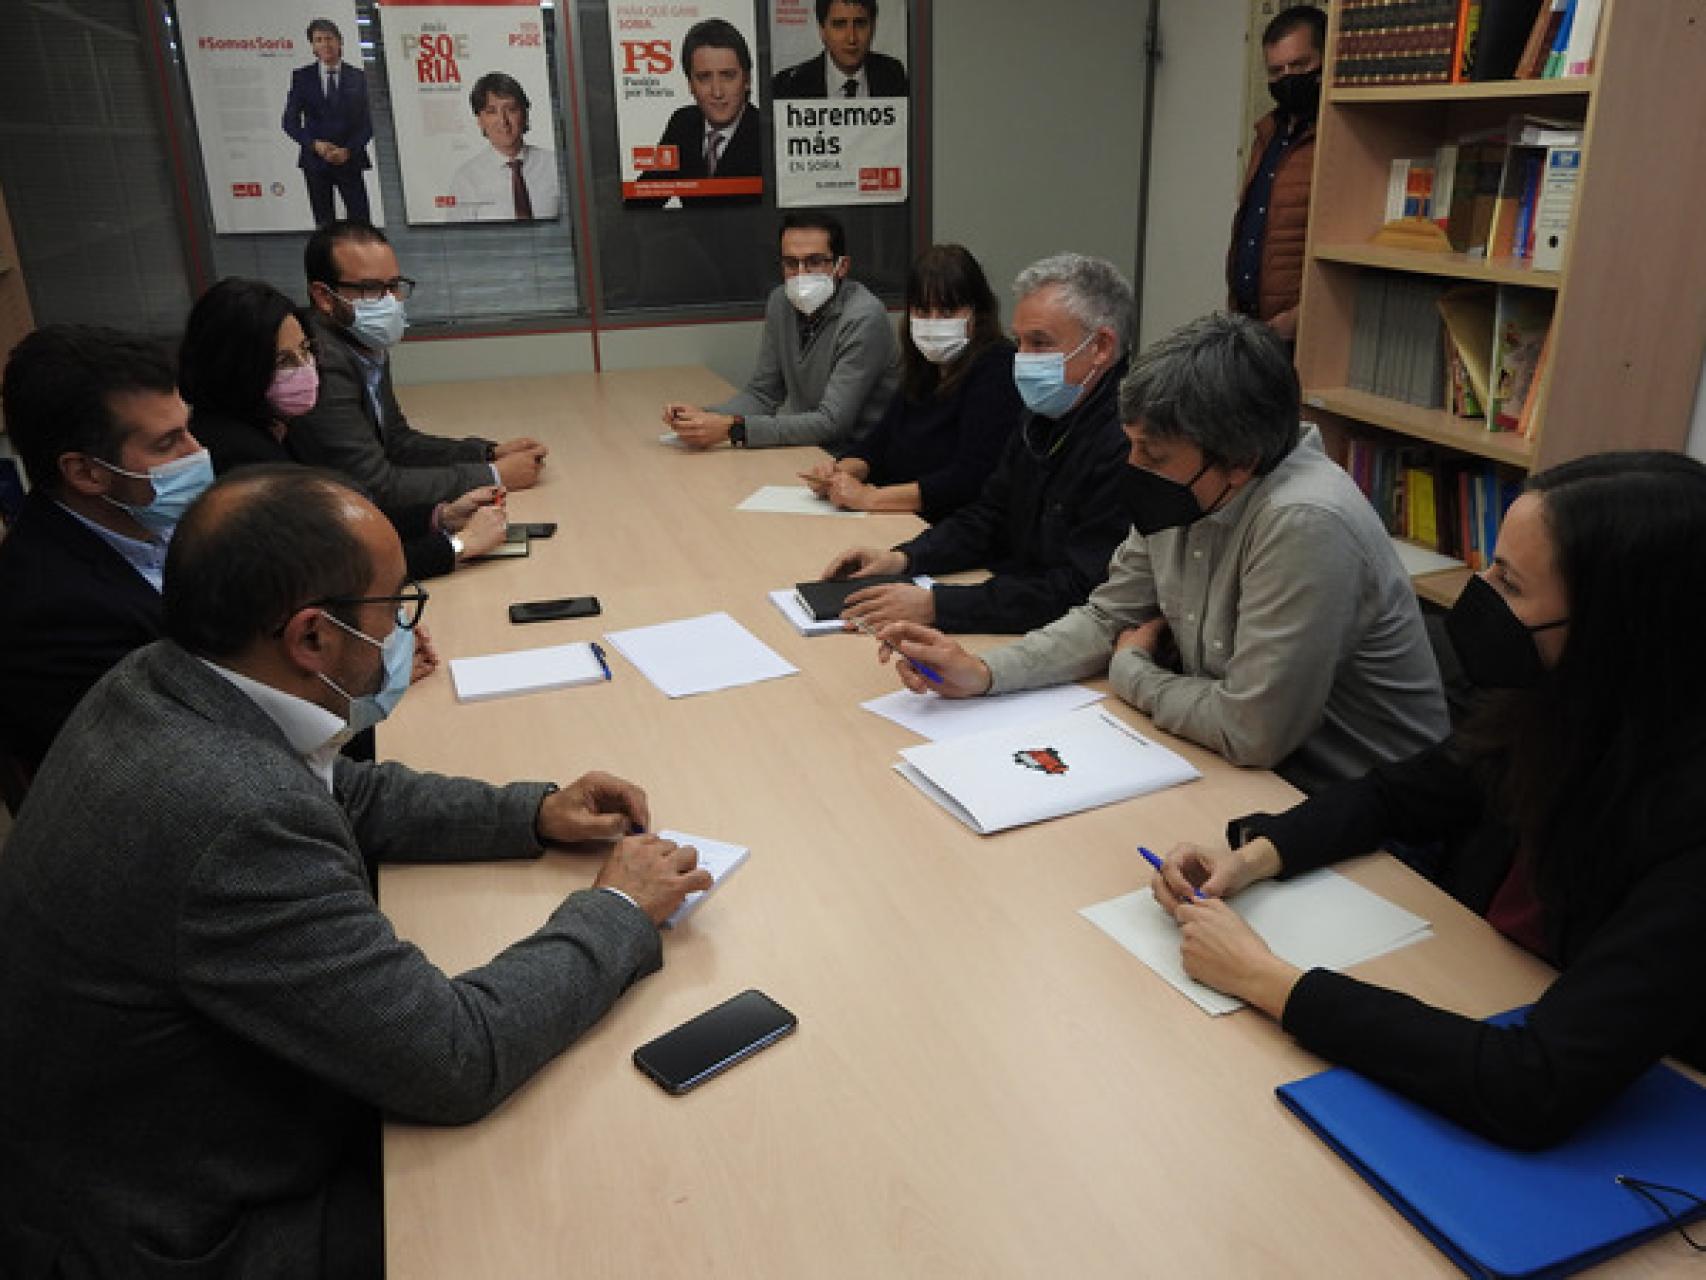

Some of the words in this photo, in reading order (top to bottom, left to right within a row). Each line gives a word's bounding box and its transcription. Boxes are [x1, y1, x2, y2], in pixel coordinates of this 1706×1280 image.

[199, 36, 293, 49] #SomosSoria
[620, 40, 674, 74] PS
[417, 60, 461, 83] RIA
[787, 103, 896, 128] haremos
[787, 130, 841, 156] más
[790, 160, 805, 172] EN
[808, 159, 841, 172] SORIA
